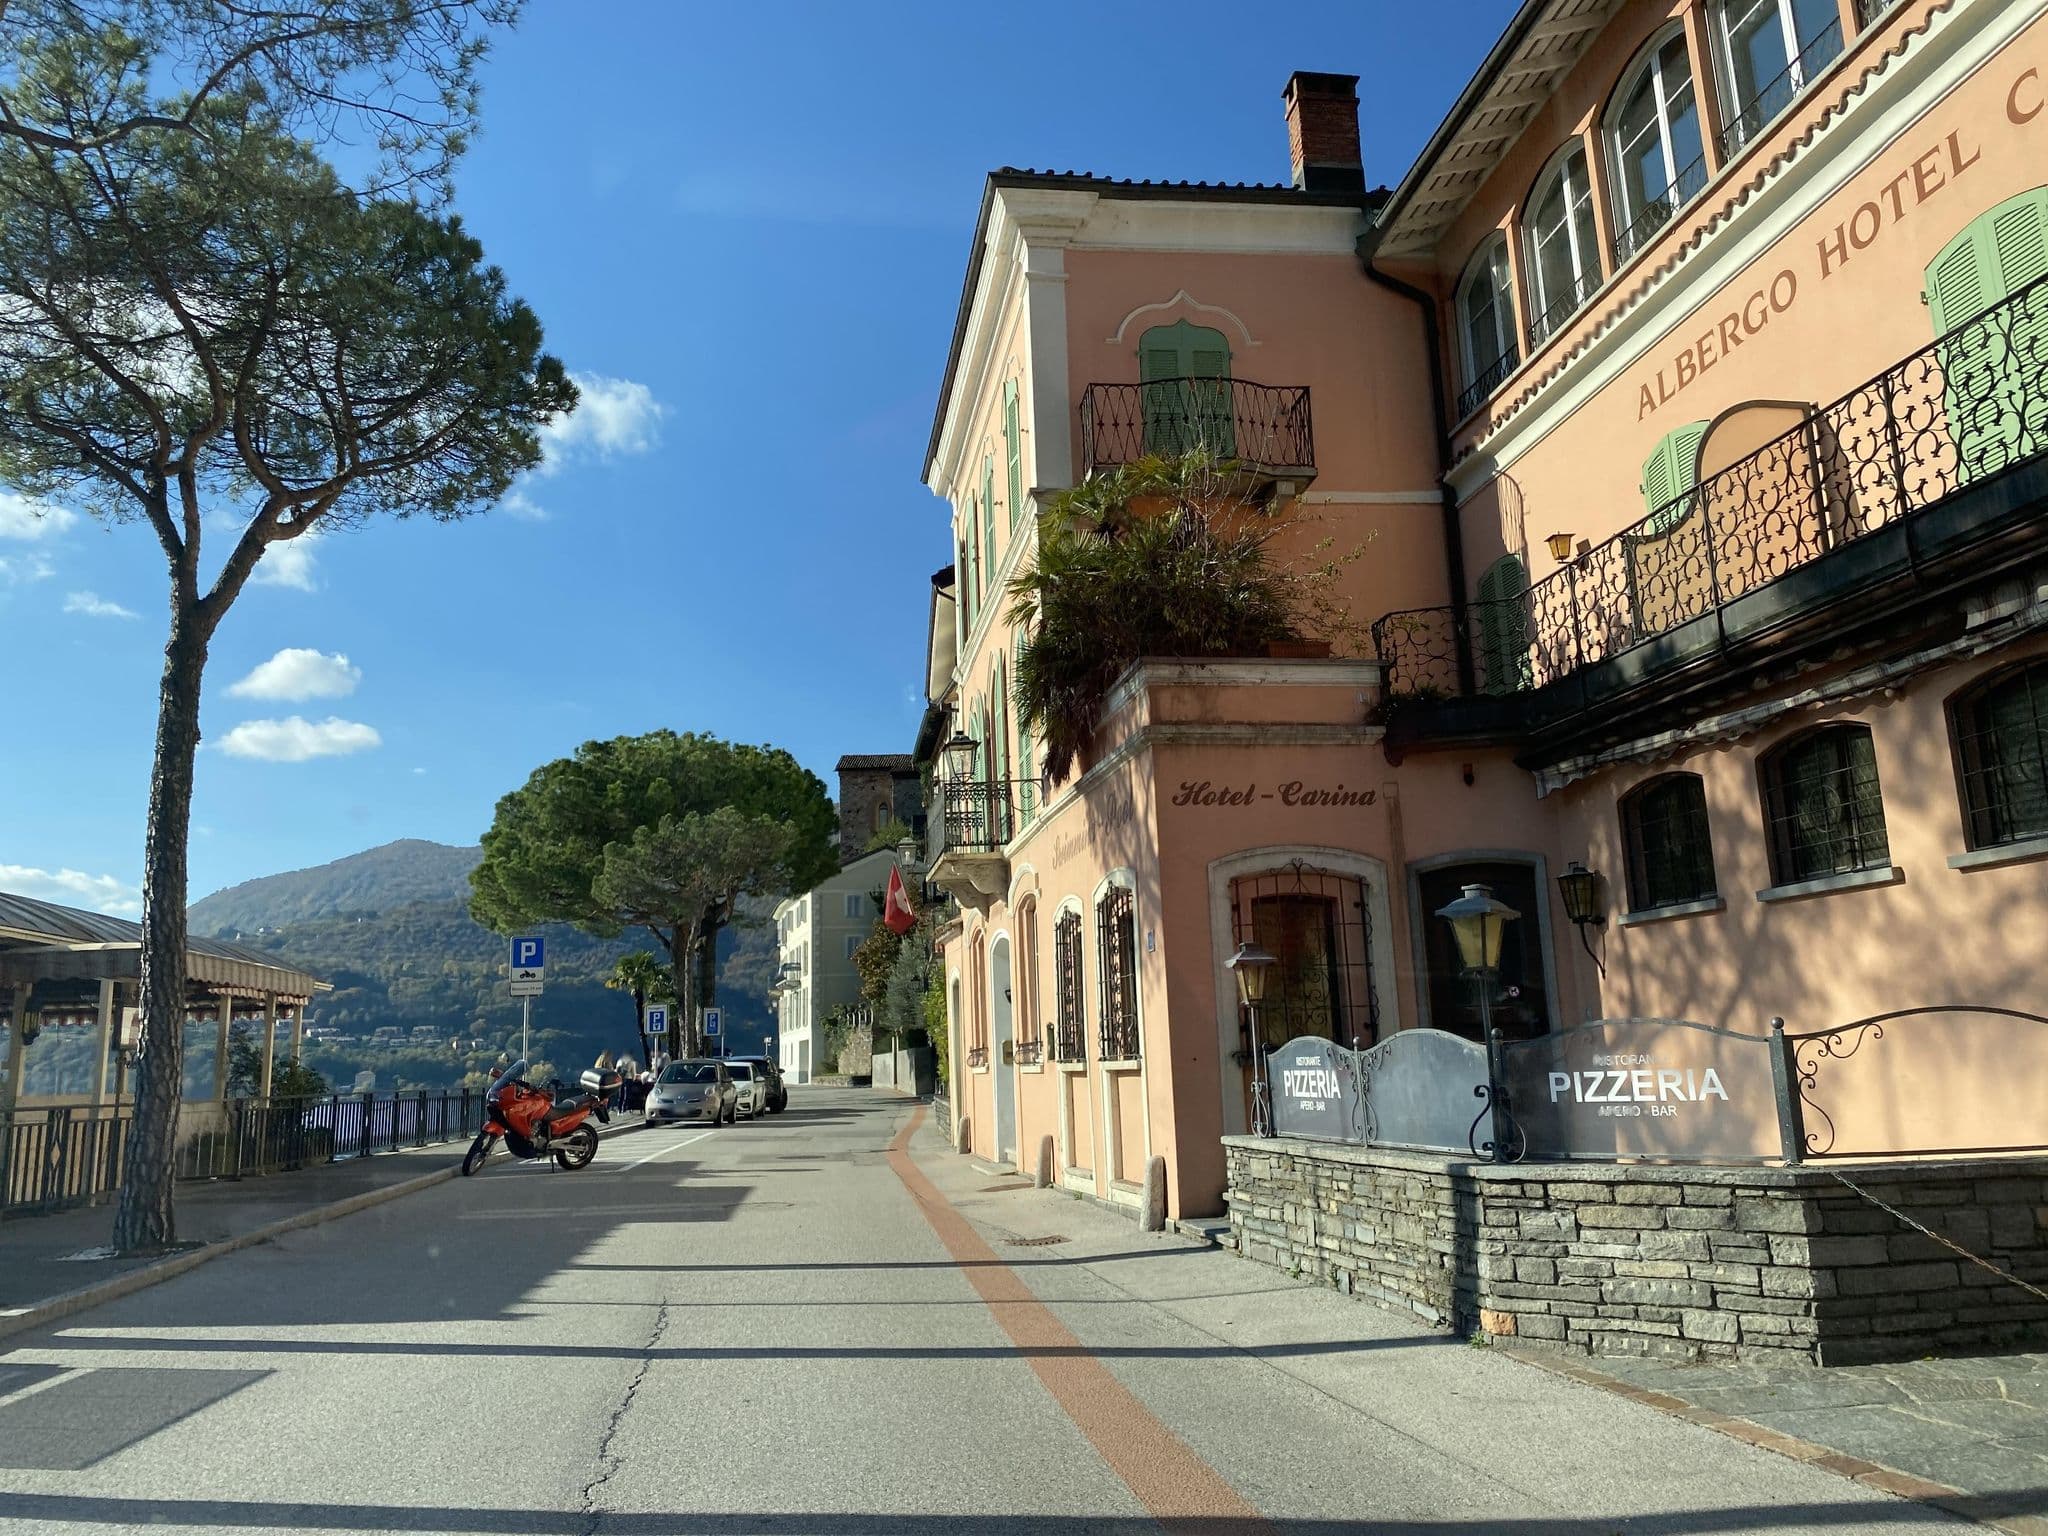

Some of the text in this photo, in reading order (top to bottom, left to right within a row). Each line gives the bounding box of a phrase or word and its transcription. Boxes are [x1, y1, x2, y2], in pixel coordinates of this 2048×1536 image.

[1637, 269, 1797, 422] ALBERGO
[1815, 128, 1982, 281] HOTEL
[1172, 781, 1256, 807] Hotel
[1278, 780, 1377, 807] Carina
[520, 941, 536, 964] P
[1283, 1069, 1342, 1099] PIZZERIA
[1548, 1068, 1729, 1103] PIZZERIA
[1651, 1105, 1679, 1117] BAR
